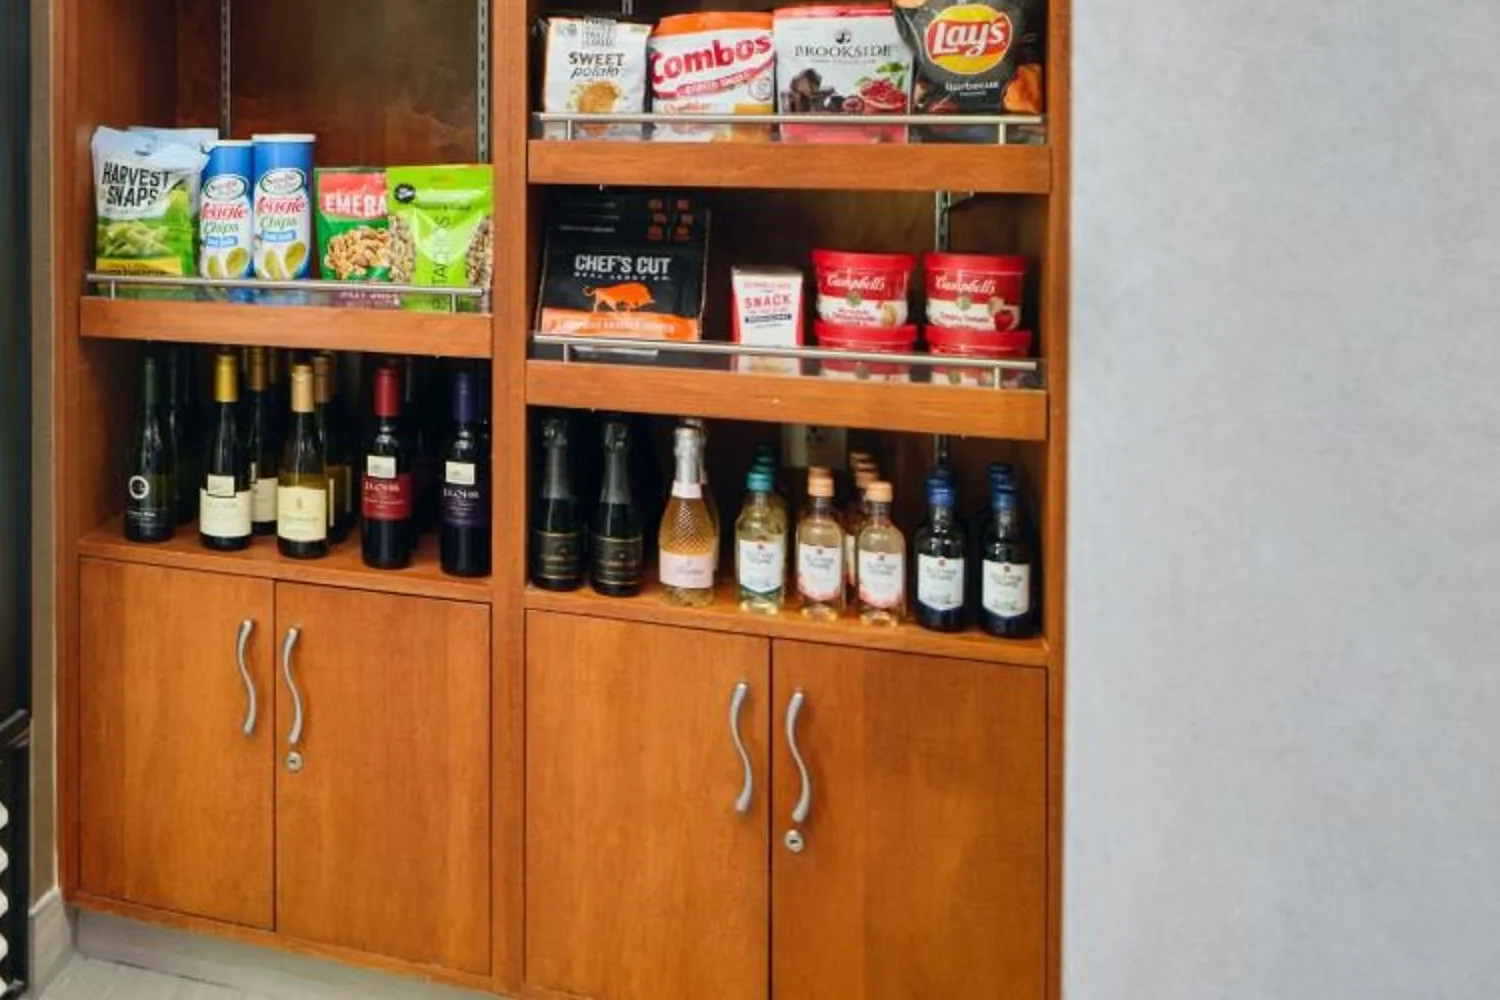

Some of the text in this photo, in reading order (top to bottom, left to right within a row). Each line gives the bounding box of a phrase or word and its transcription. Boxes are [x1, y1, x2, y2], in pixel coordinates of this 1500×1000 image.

[933, 15, 1006, 58] Lay's
[568, 51, 625, 67] SWEET
[651, 35, 772, 85] Combos
[794, 45, 891, 58] BROOKSIDE
[102, 161, 172, 189] HARVEST
[107, 185, 159, 207] SNAPS
[324, 190, 388, 218] EMERA
[574, 254, 672, 275] CHEF'S CUT
